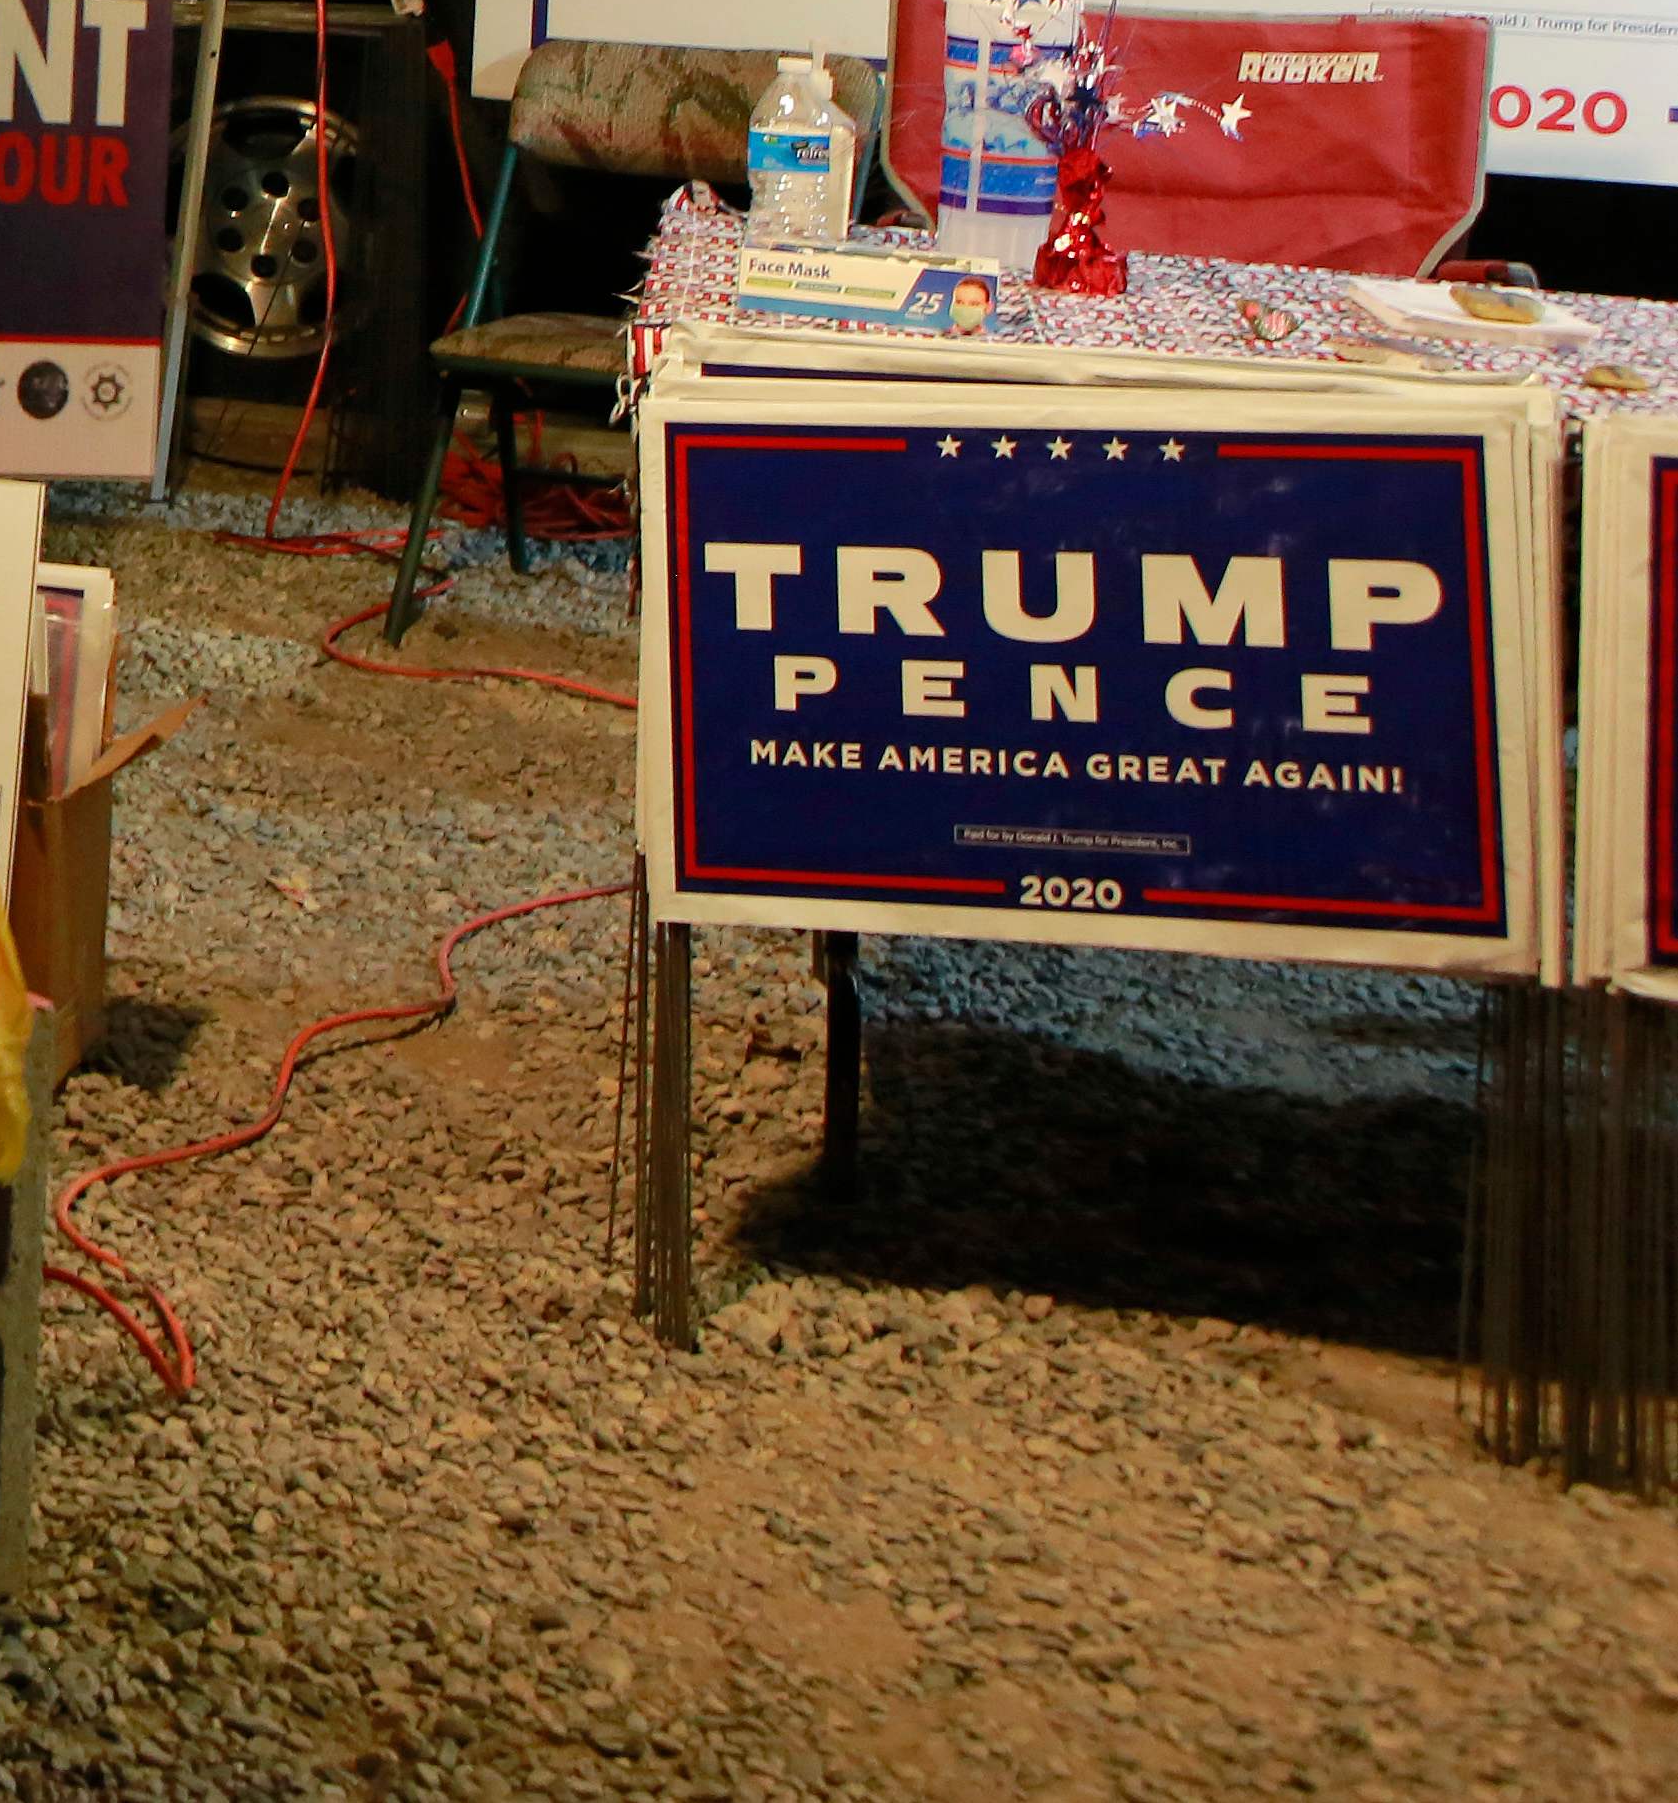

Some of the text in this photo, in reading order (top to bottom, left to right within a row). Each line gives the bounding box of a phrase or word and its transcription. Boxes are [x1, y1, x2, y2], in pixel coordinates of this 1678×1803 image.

[1535, 16, 1584, 33] Trump
[748, 257, 831, 279] Face Mask
[907, 290, 944, 316] 25
[703, 540, 1443, 653] TRUMP
[772, 653, 1373, 735] PENCE
[750, 739, 1404, 794] MAKE AMERICA GREAT AGAIN!
[1018, 874, 1123, 910] 2020
